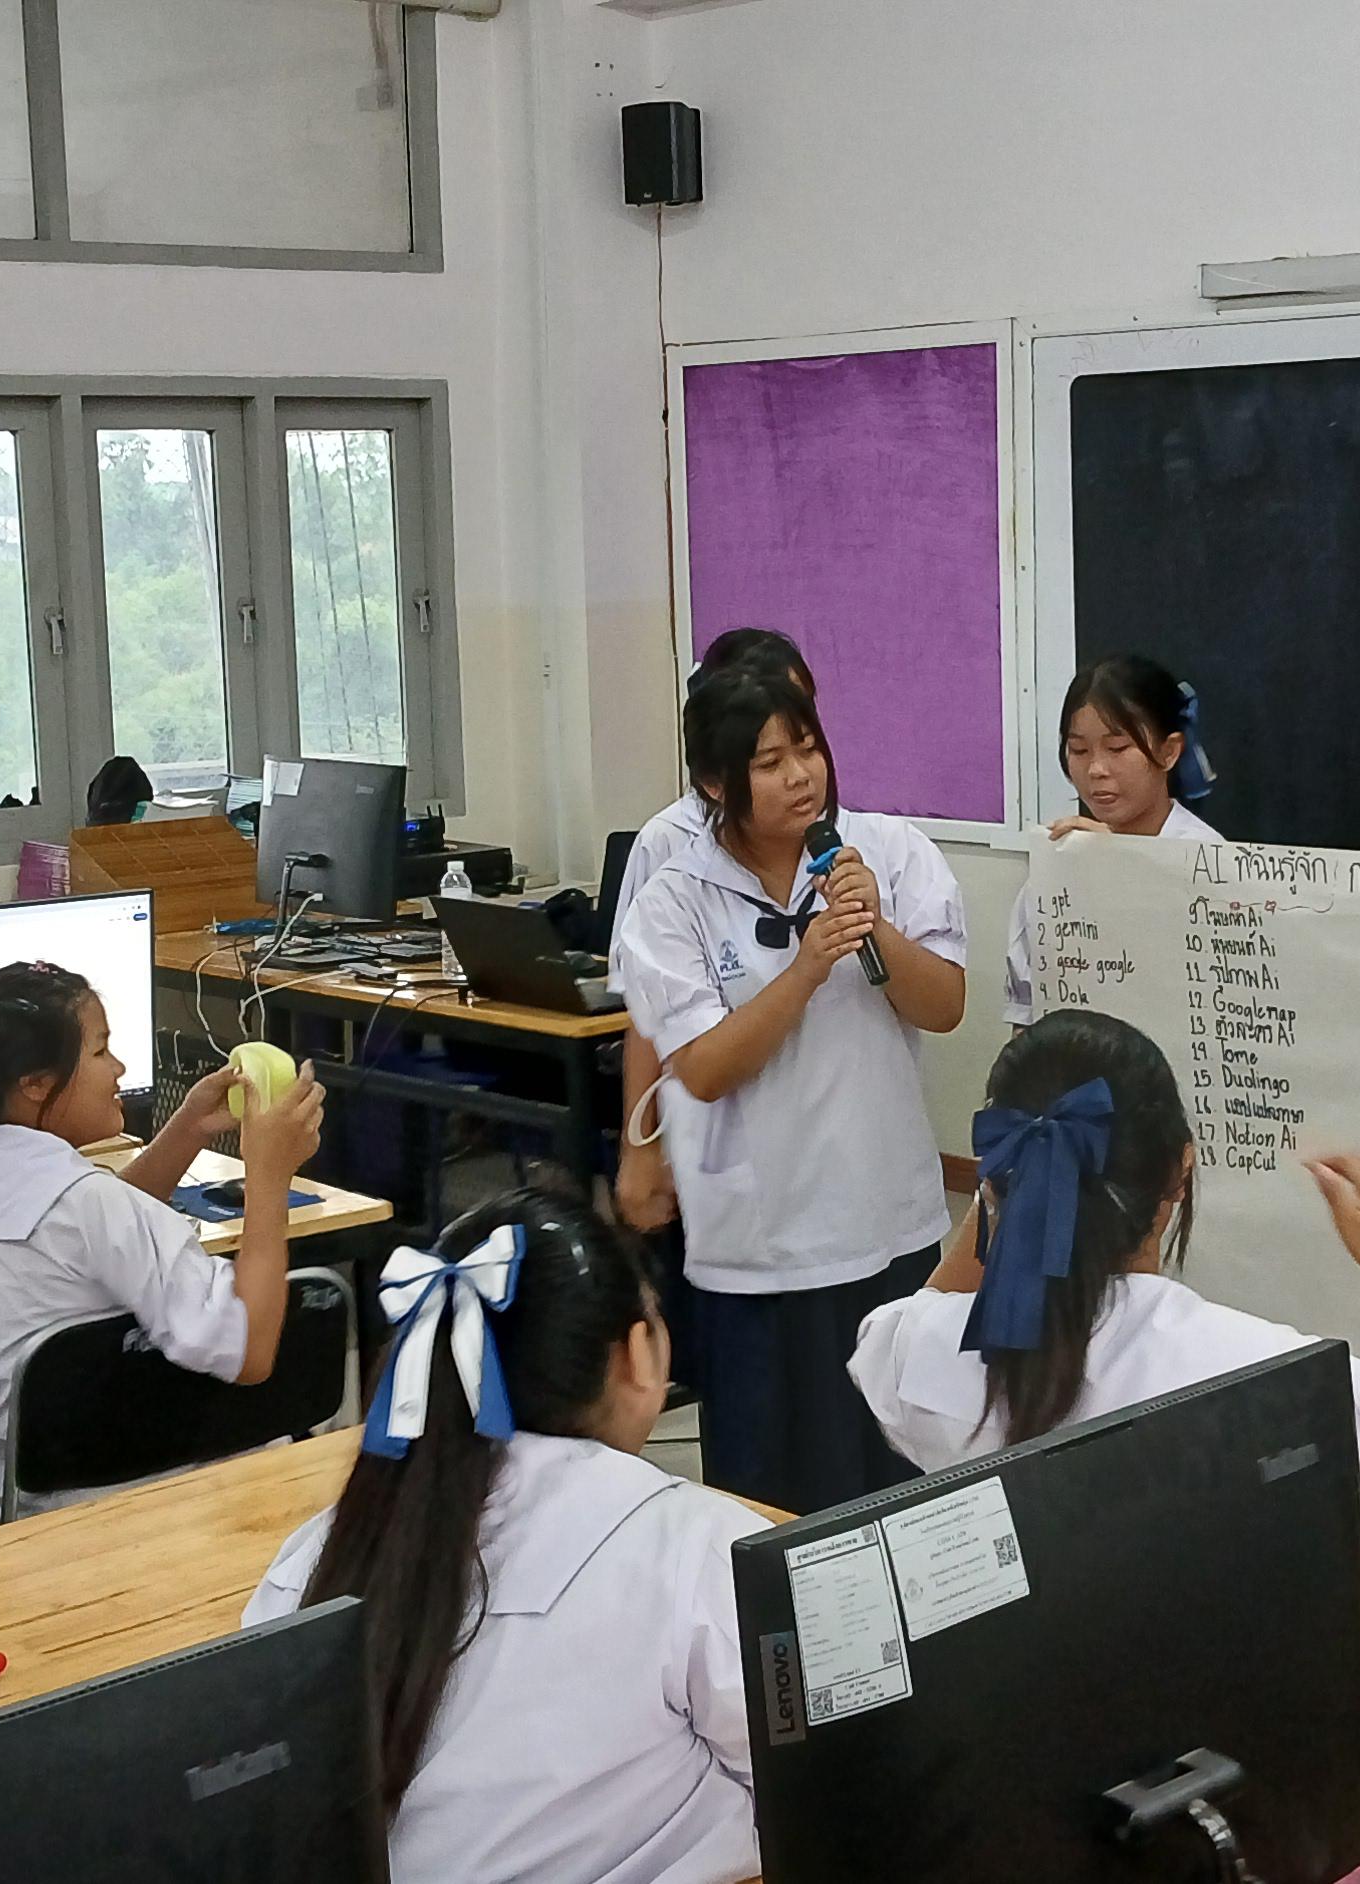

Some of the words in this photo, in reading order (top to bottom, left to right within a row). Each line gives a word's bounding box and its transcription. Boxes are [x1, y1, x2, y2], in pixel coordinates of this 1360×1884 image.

[1192, 843, 1228, 884] AI
[1051, 887, 1071, 918] gpt
[1055, 917, 1098, 951] gemini
[1096, 949, 1135, 983] google
[1215, 1035, 1258, 1065] Tome
[1225, 1120, 1275, 1148] Notion
[1280, 1124, 1296, 1150] Ai
[1226, 1146, 1276, 1175] CapCut
[773, 1642, 795, 1734] Lenovo
